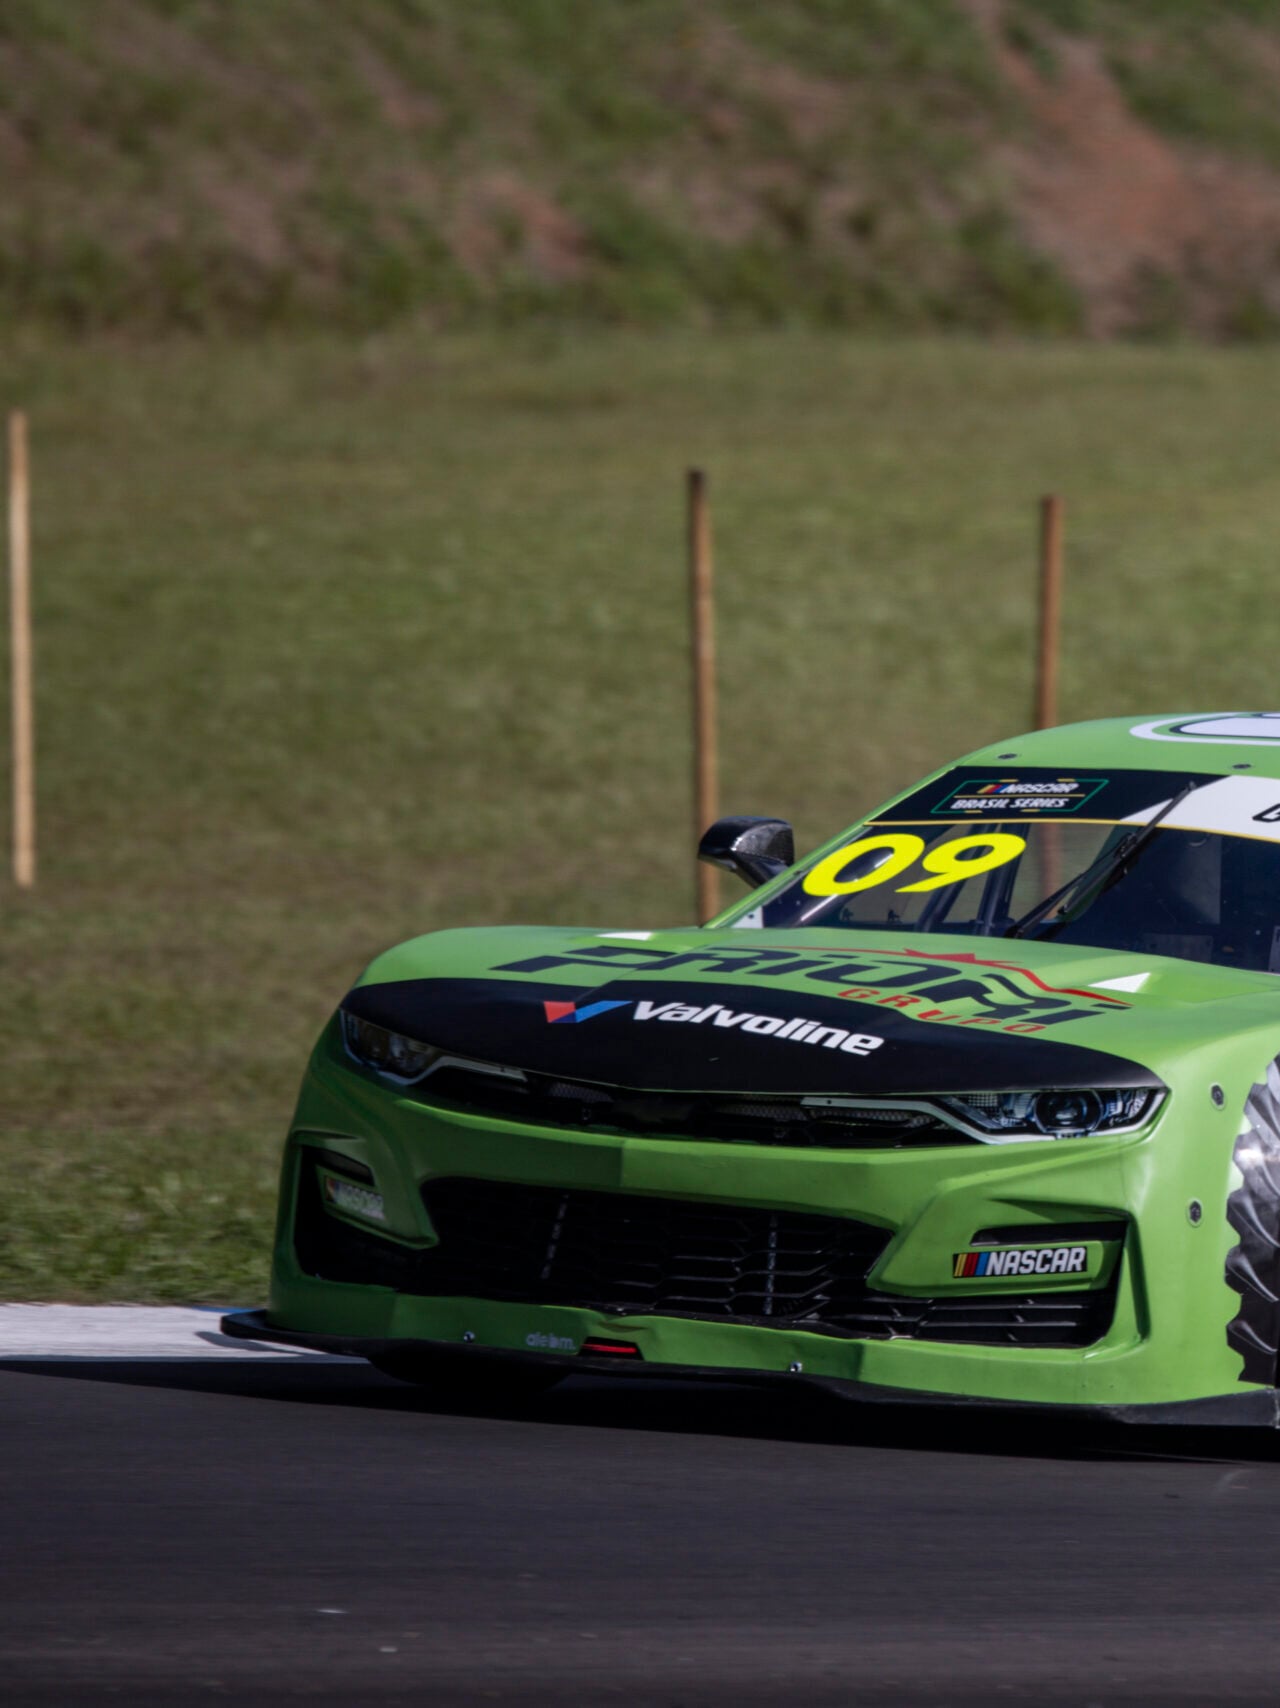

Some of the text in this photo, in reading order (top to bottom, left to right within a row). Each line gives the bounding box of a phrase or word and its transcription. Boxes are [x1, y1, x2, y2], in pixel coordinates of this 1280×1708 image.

[950, 797, 1069, 810] BRASIL SERIES
[1000, 783, 1080, 794] NASCAR
[802, 833, 1026, 897] 09
[633, 1000, 885, 1056] Valvoline
[837, 987, 1047, 1034] GRUPO
[986, 1247, 1086, 1276] NASCAR
